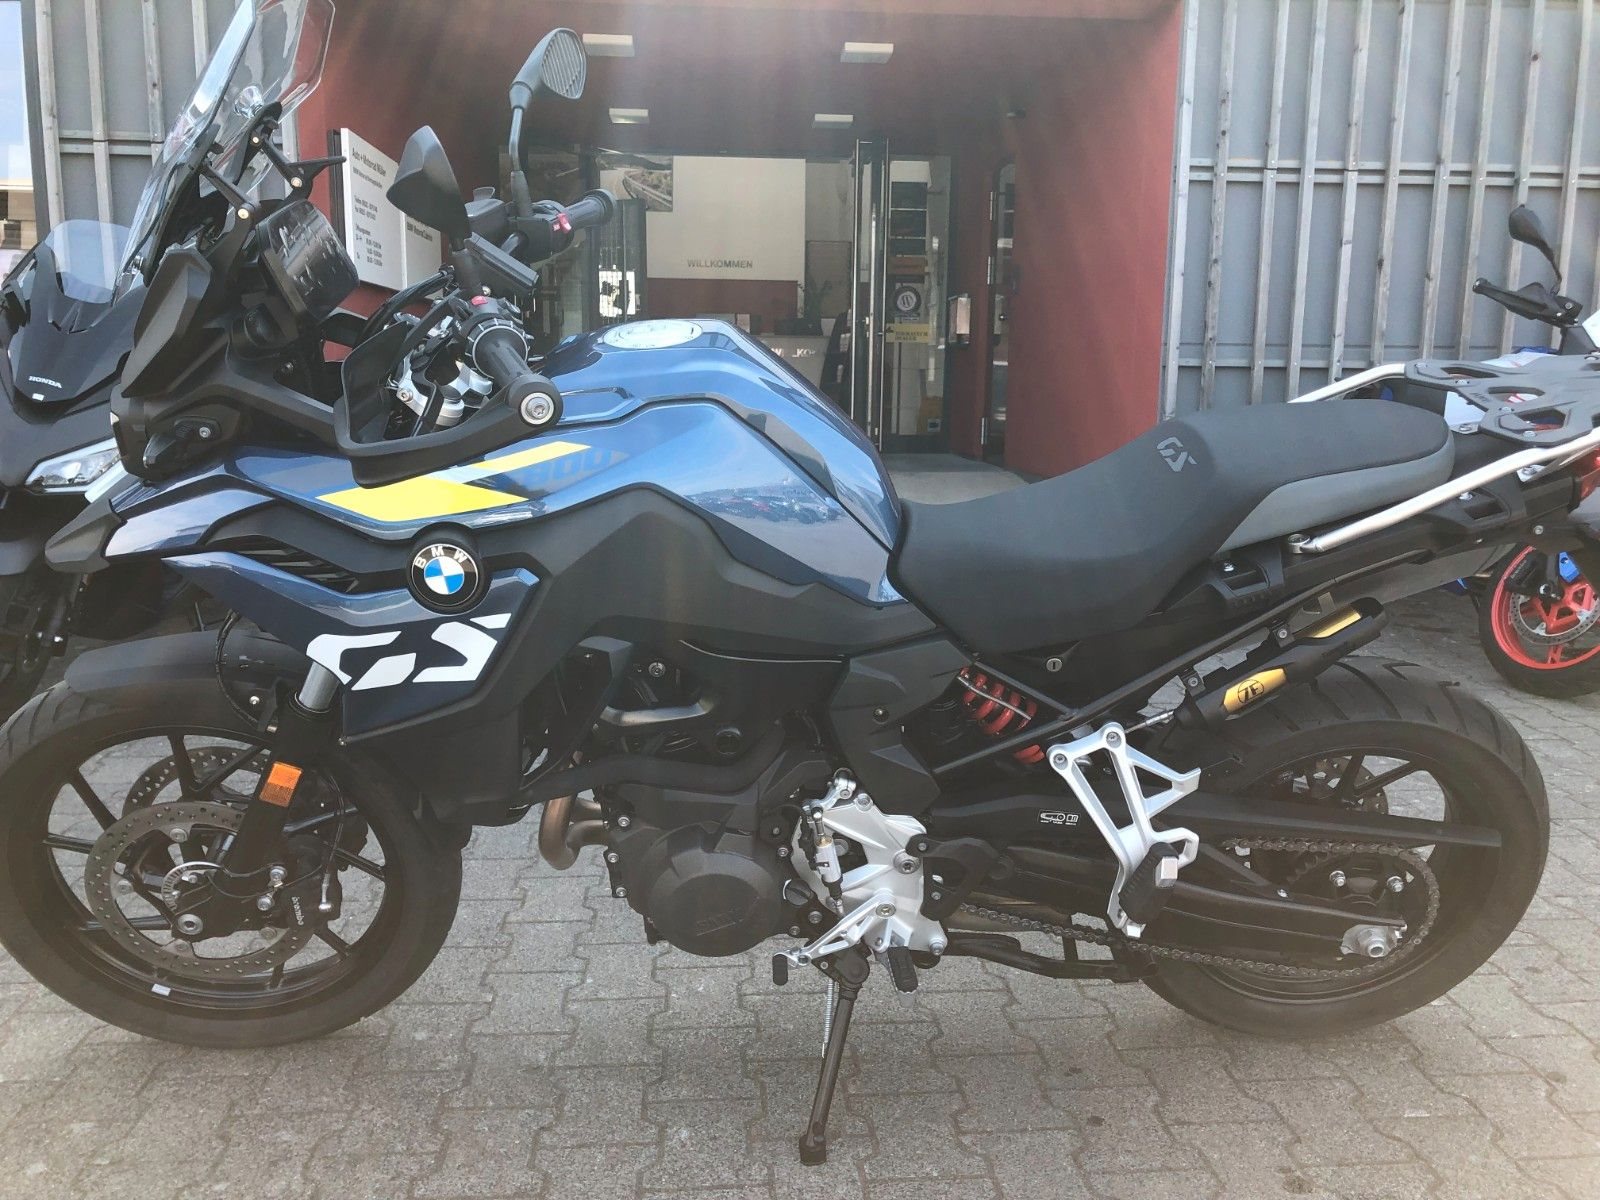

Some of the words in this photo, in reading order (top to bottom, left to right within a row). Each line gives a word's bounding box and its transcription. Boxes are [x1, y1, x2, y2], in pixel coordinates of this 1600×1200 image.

[687, 259, 753, 269] WILLKOMMEN
[29, 375, 62, 389] HONDA
[413, 545, 468, 570] BMW
[306, 613, 512, 691] GS
[291, 896, 304, 926] brembo
